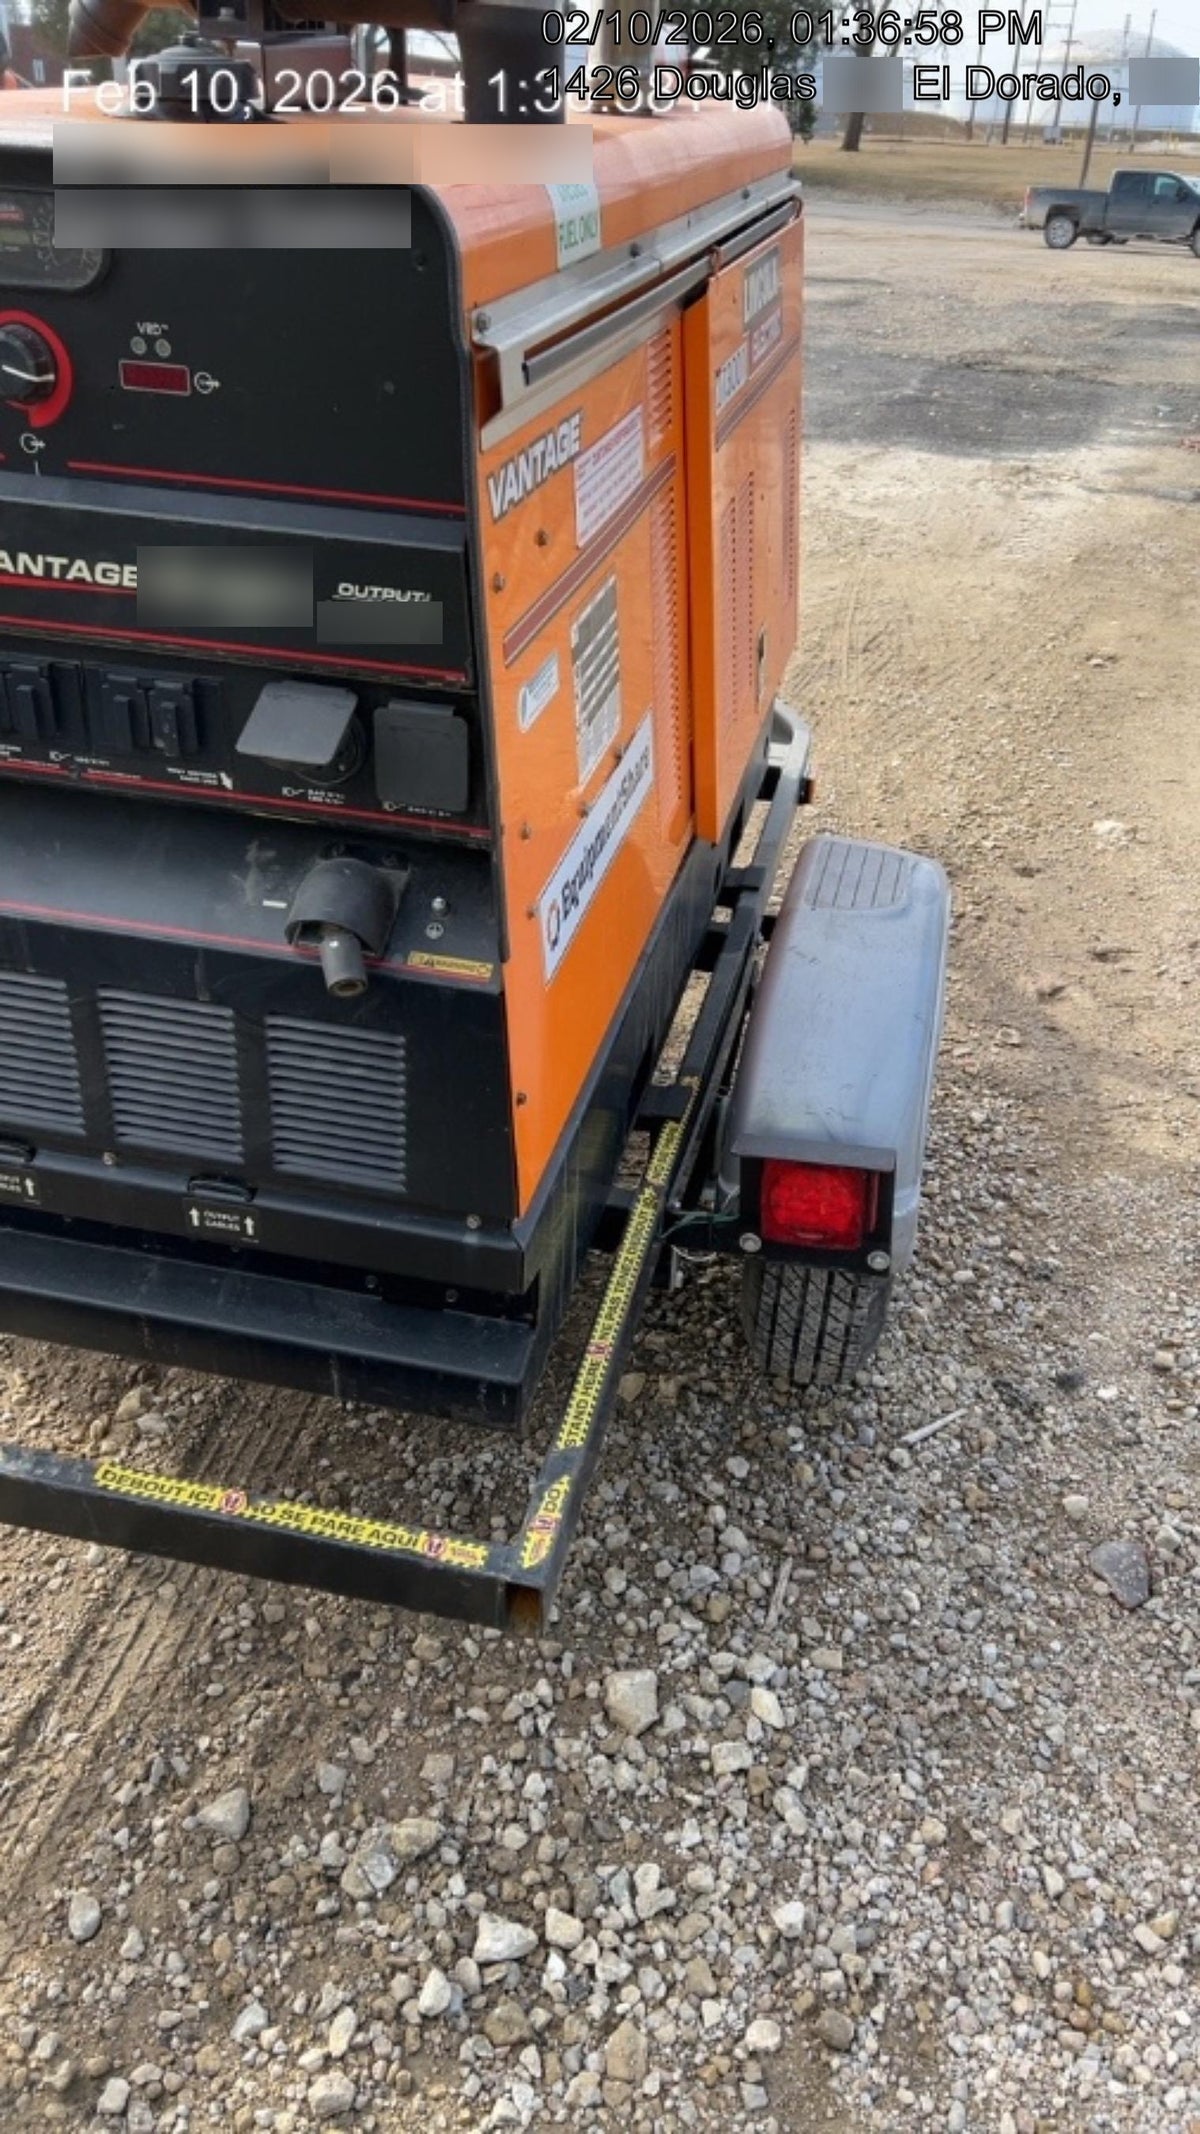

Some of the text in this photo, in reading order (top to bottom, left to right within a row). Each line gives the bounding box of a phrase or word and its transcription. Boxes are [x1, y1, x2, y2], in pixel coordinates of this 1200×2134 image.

[487, 411, 582, 522] VANTAGE
[564, 1399, 589, 1446] STAND
[101, 1469, 188, 1497] DEBOUT
[310, 1513, 366, 1537] PARE
[368, 1528, 420, 1549] AQUI
